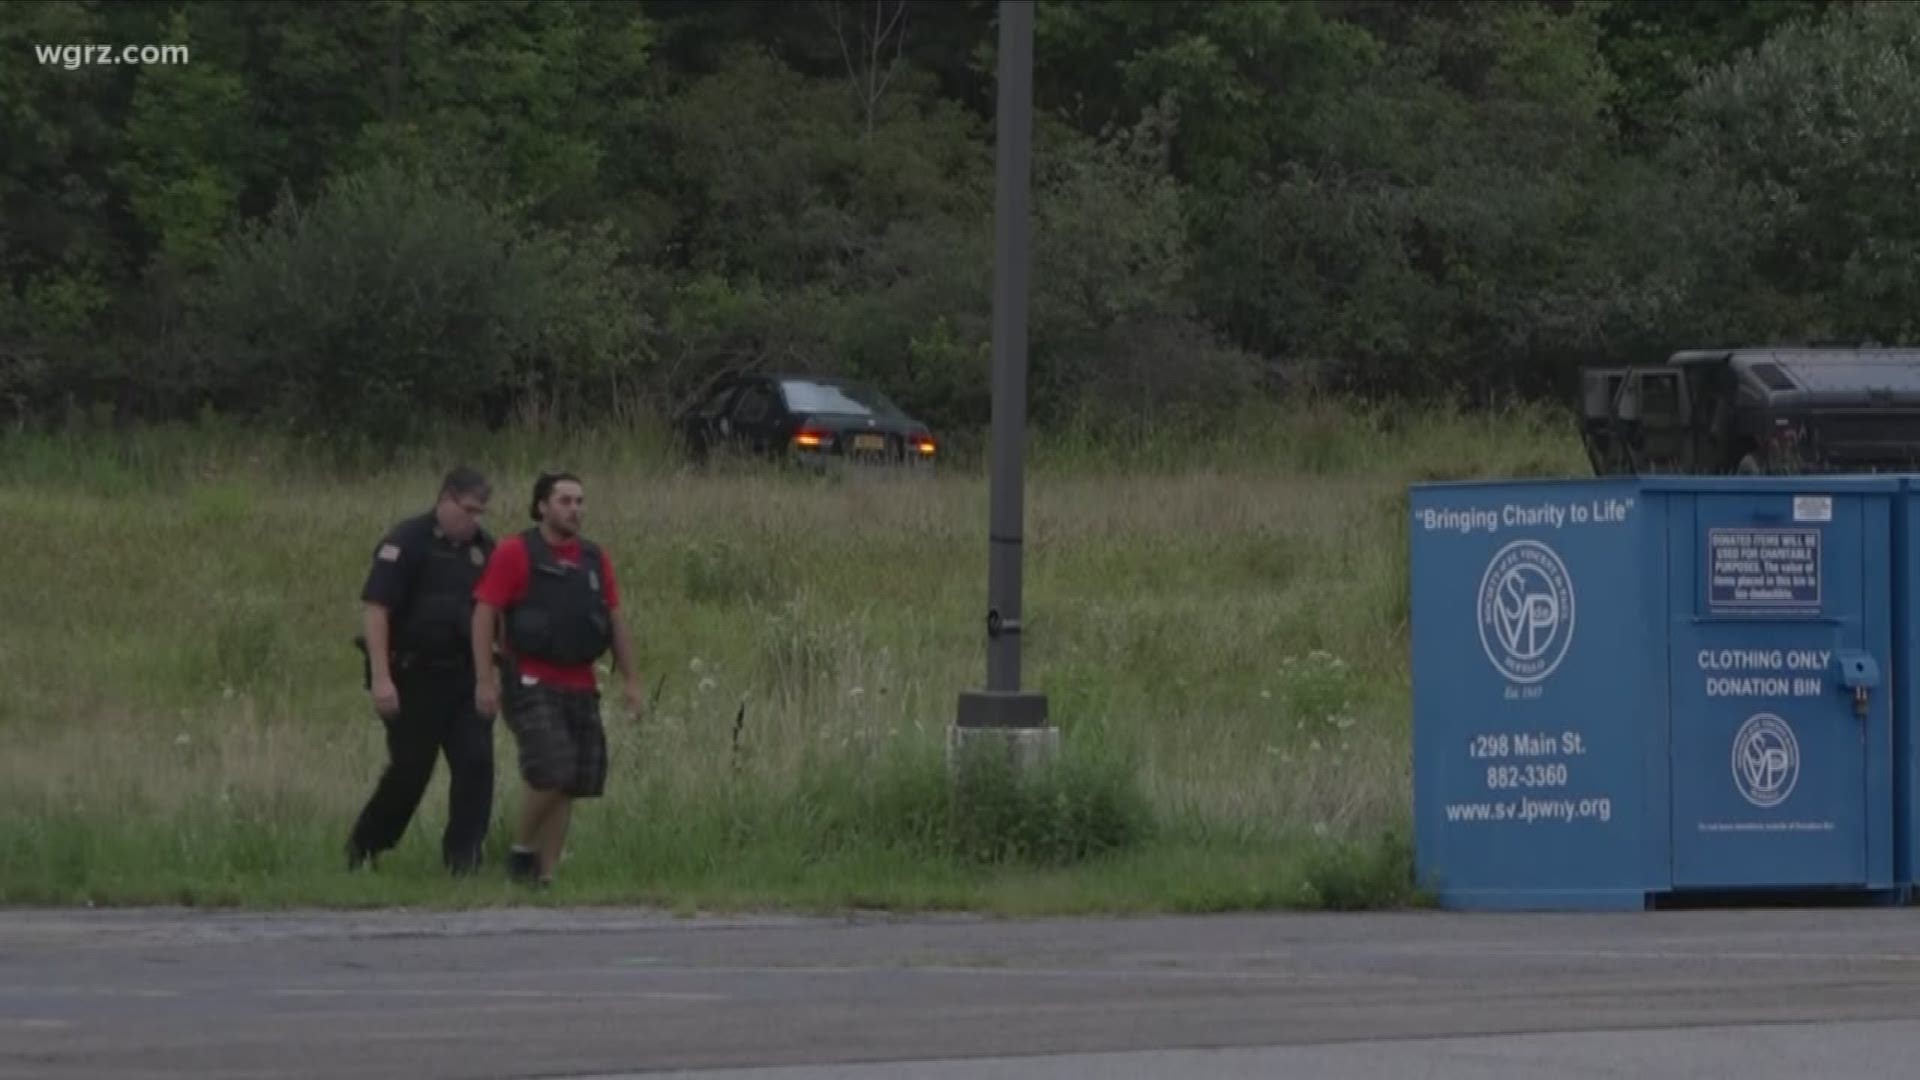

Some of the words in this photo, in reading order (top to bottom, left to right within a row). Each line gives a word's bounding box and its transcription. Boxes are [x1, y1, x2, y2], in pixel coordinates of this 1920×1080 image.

[1503, 503, 1565, 528] Charity
[1570, 503, 1588, 522] to
[1698, 650, 1782, 669] CLOTHING
[1787, 650, 1831, 669] ONLY
[1707, 678, 1788, 696] DONATION
[1794, 678, 1821, 696] BIN
[1514, 732, 1556, 756] Main
[1562, 731, 1586, 754] St.
[1487, 763, 1568, 789] 882-3360
